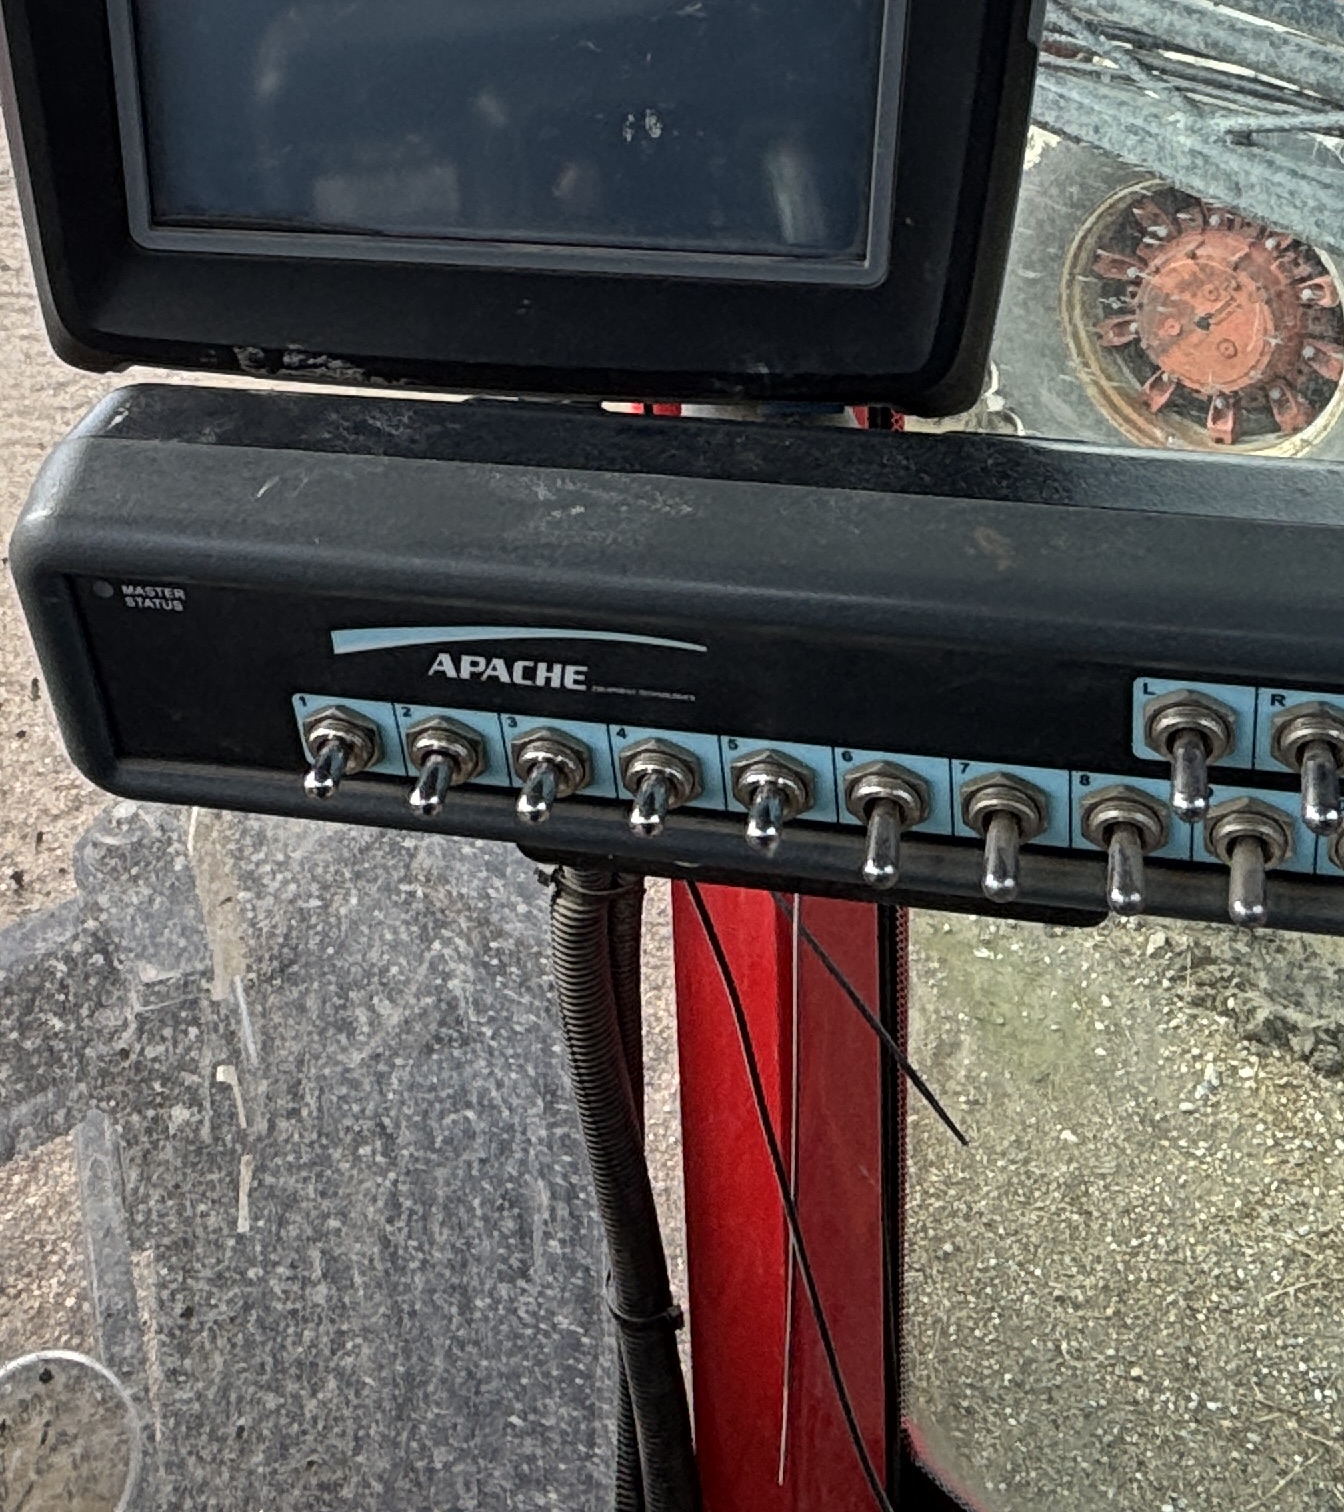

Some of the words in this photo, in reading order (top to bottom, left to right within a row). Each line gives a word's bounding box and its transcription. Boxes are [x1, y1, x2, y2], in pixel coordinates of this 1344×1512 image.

[121, 584, 186, 600] MASTER
[124, 596, 184, 612] STATUS
[427, 652, 589, 691] APACHE
[1142, 682, 1156, 695] L
[1270, 693, 1286, 707] R
[298, 695, 308, 707] 1
[400, 706, 412, 718] 2
[506, 716, 518, 728] 3
[616, 727, 628, 740] 4
[728, 738, 740, 751] 5
[841, 750, 854, 763] 6
[959, 762, 971, 775] 7
[1079, 773, 1091, 786] 8
